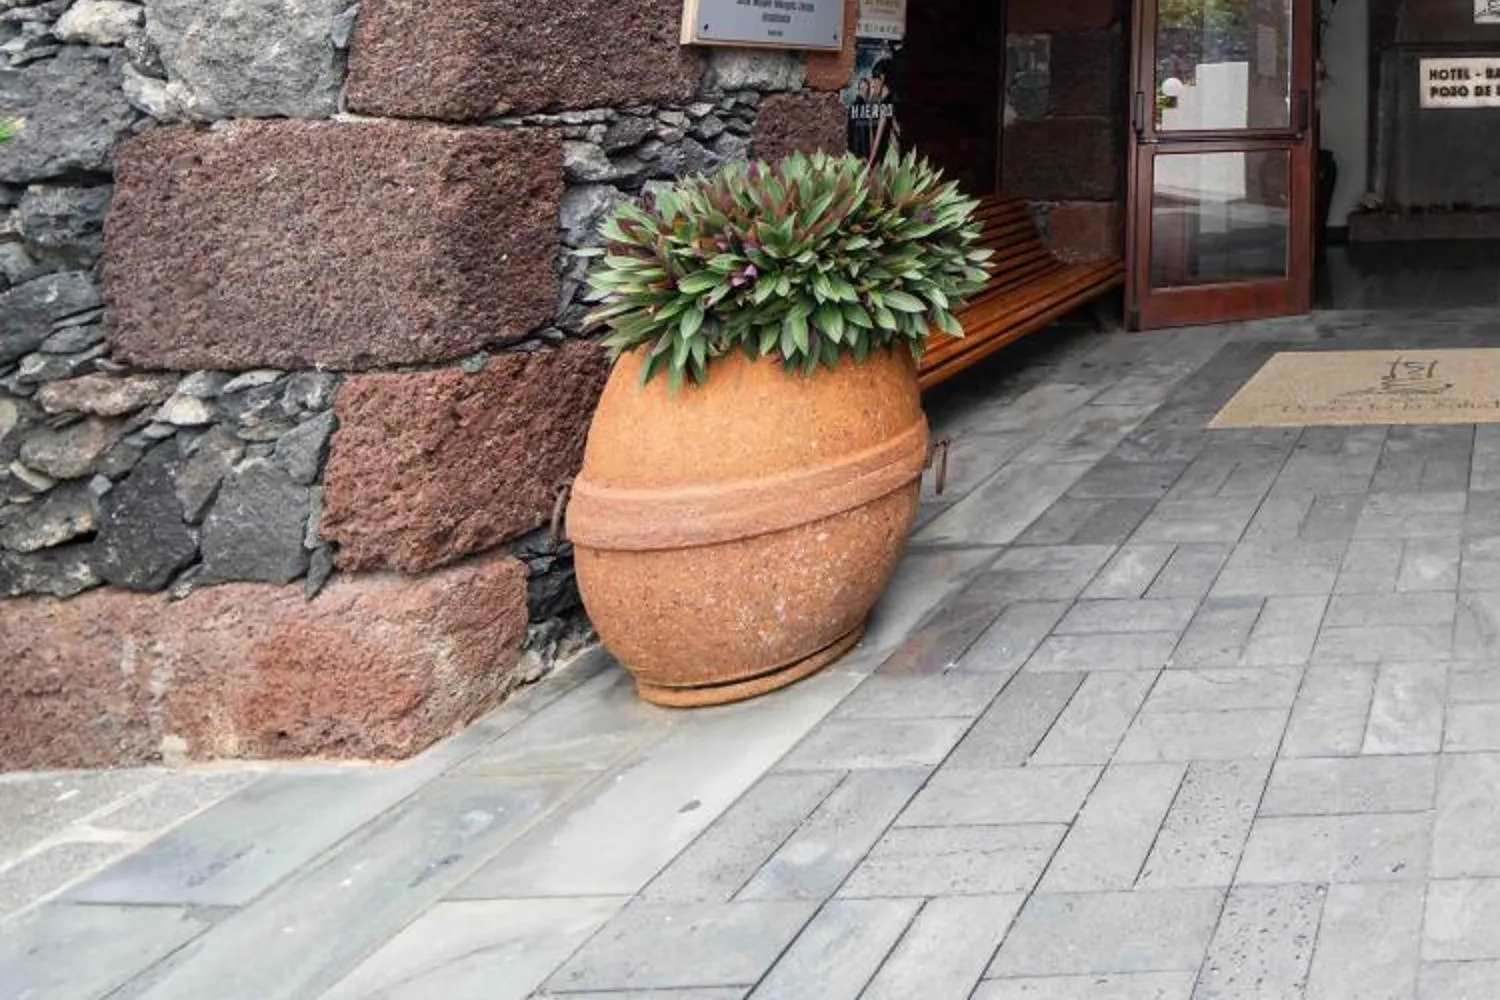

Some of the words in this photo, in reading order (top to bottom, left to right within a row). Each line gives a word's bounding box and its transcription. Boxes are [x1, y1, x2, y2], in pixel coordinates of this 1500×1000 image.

[1429, 68, 1471, 80] HOTEL
[1429, 85, 1469, 97] POZO
[1474, 85, 1491, 97] DE
[851, 103, 893, 119] HIERRO
